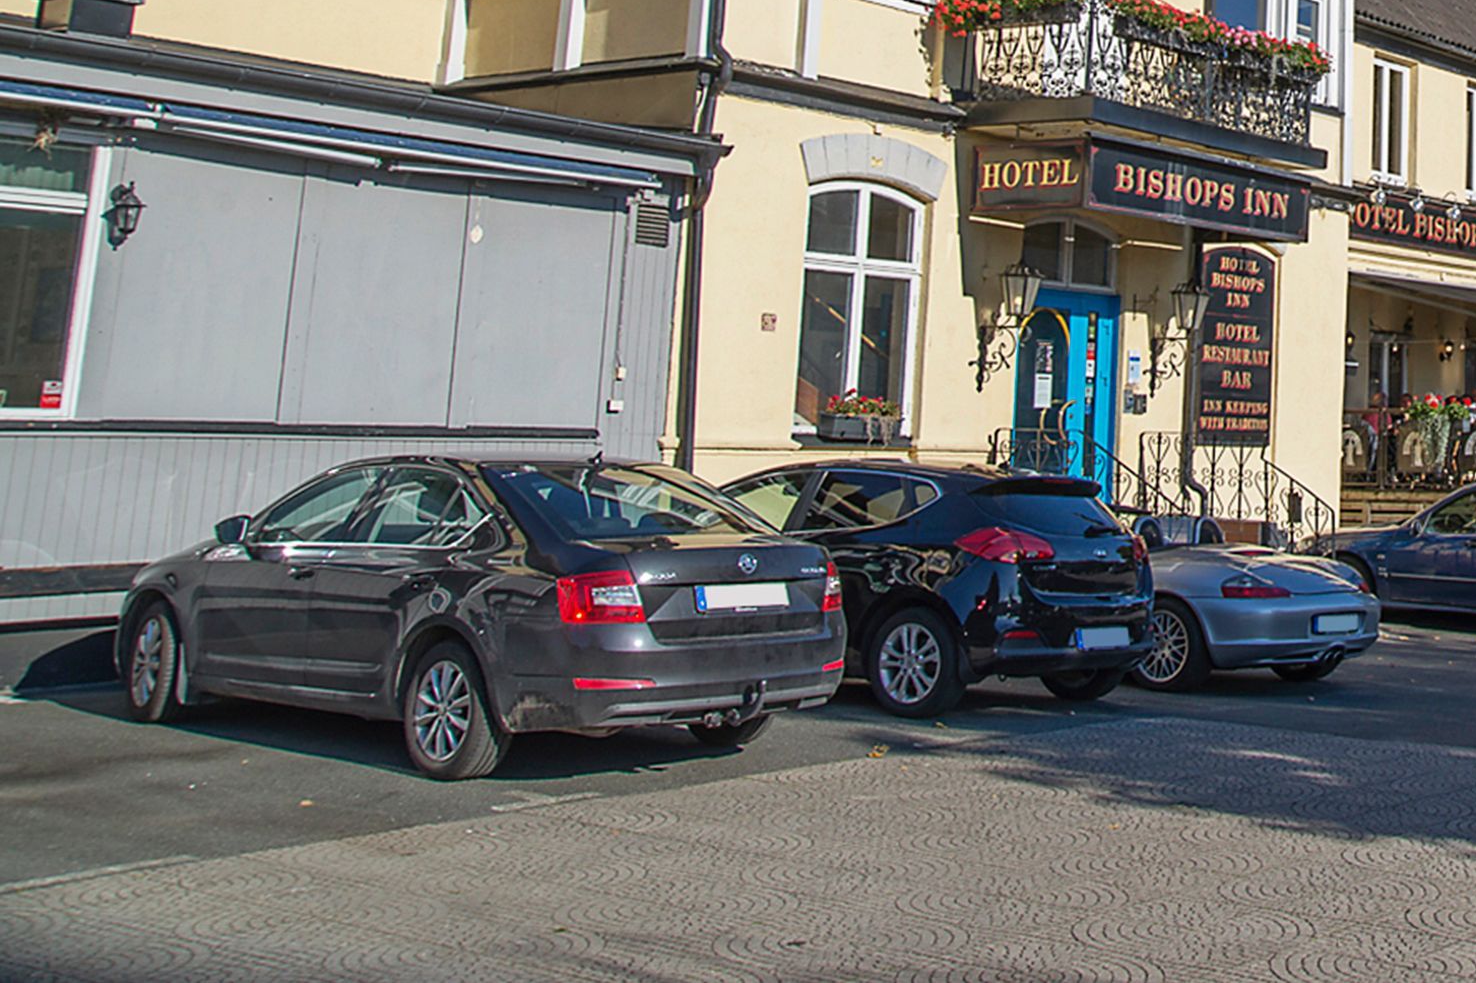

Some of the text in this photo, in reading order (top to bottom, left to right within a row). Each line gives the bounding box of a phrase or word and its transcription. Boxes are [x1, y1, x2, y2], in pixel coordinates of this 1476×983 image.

[979, 158, 1290, 219] HOTEL BISHOPS INN
[1353, 202, 1410, 235] OTEL
[1219, 256, 1261, 275] HOTEL
[1210, 271, 1266, 293] BISHOPS
[1225, 291, 1250, 309] INN
[1215, 322, 1260, 343] HOTEL
[1201, 344, 1270, 367] RESTAURANT
[1220, 369, 1252, 390] BAR
[1203, 399, 1268, 415] INN KEEPING
[1200, 416, 1268, 432] WITH TRADITION
